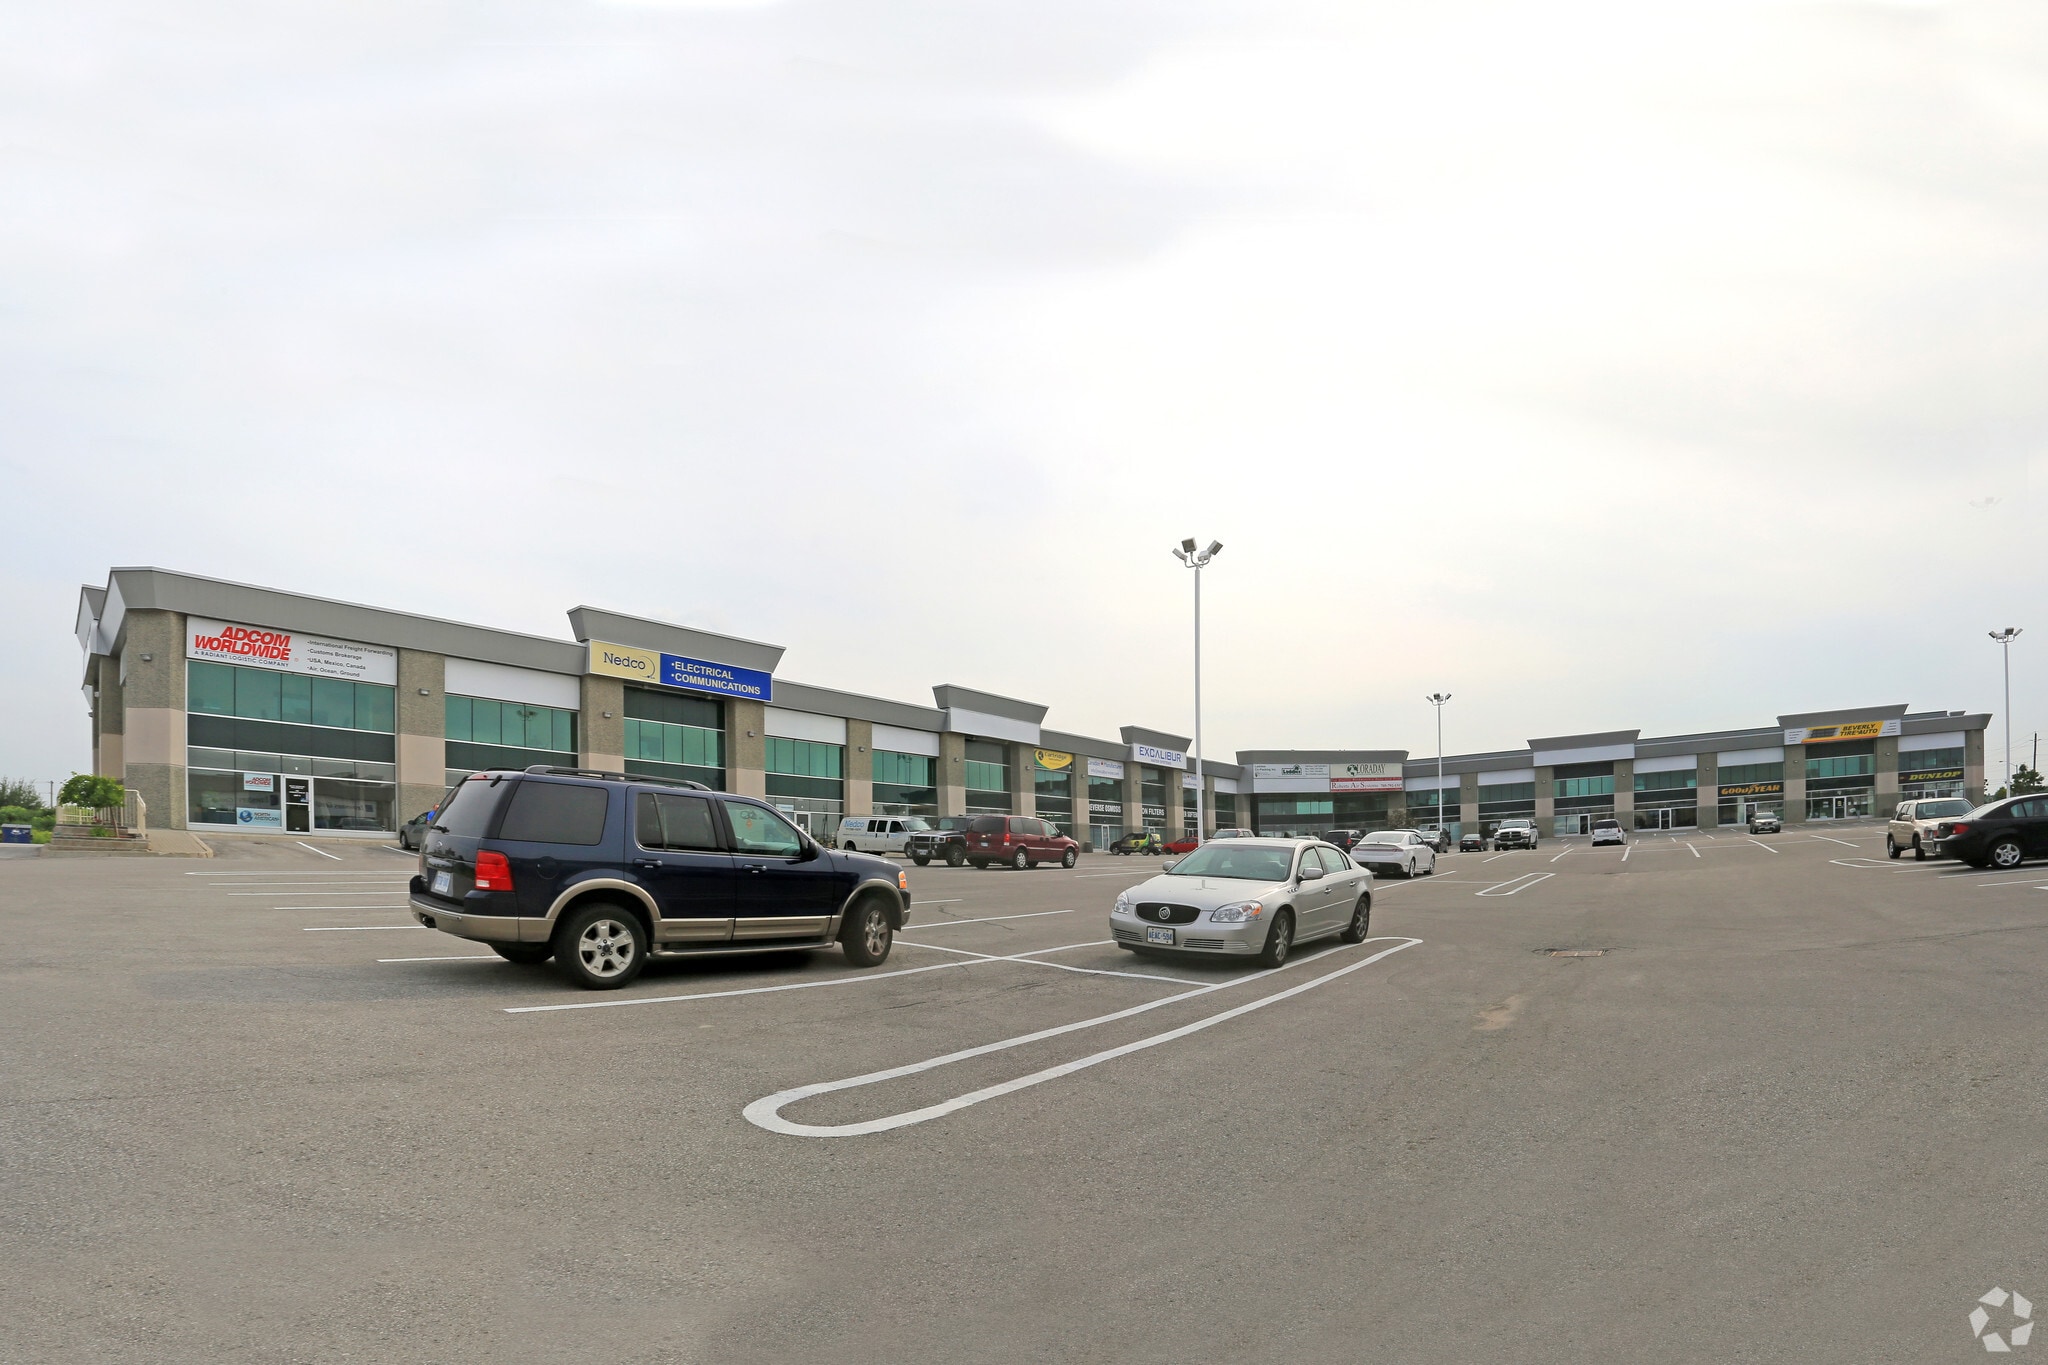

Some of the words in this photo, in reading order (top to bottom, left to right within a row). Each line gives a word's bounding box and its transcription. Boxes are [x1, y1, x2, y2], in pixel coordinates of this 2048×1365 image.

[220, 626, 291, 647] ADCOM
[195, 634, 292, 661] WORLDWIDE
[310, 640, 343, 650] International
[364, 646, 393, 656] Forwarding
[310, 648, 334, 656] Customs
[334, 652, 362, 660] Brokerage
[201, 651, 228, 660] RADIANT
[229, 655, 256, 664] LOGISTIC
[258, 659, 289, 668] COMPANY
[603, 652, 646, 670] Nedco
[674, 661, 734, 680] ELECTRICAL
[674, 672, 761, 695] COMMUNICATIONS
[1044, 752, 1067, 760] Cartridge
[1139, 746, 1182, 762] EXCALIBUR
[1358, 764, 1386, 774] LORADAY
[1909, 771, 1962, 781] DUNLOP
[1721, 784, 1780, 794] GOODYEAR
[1149, 808, 1164, 816] FILTERS
[844, 820, 865, 828] Nedco
